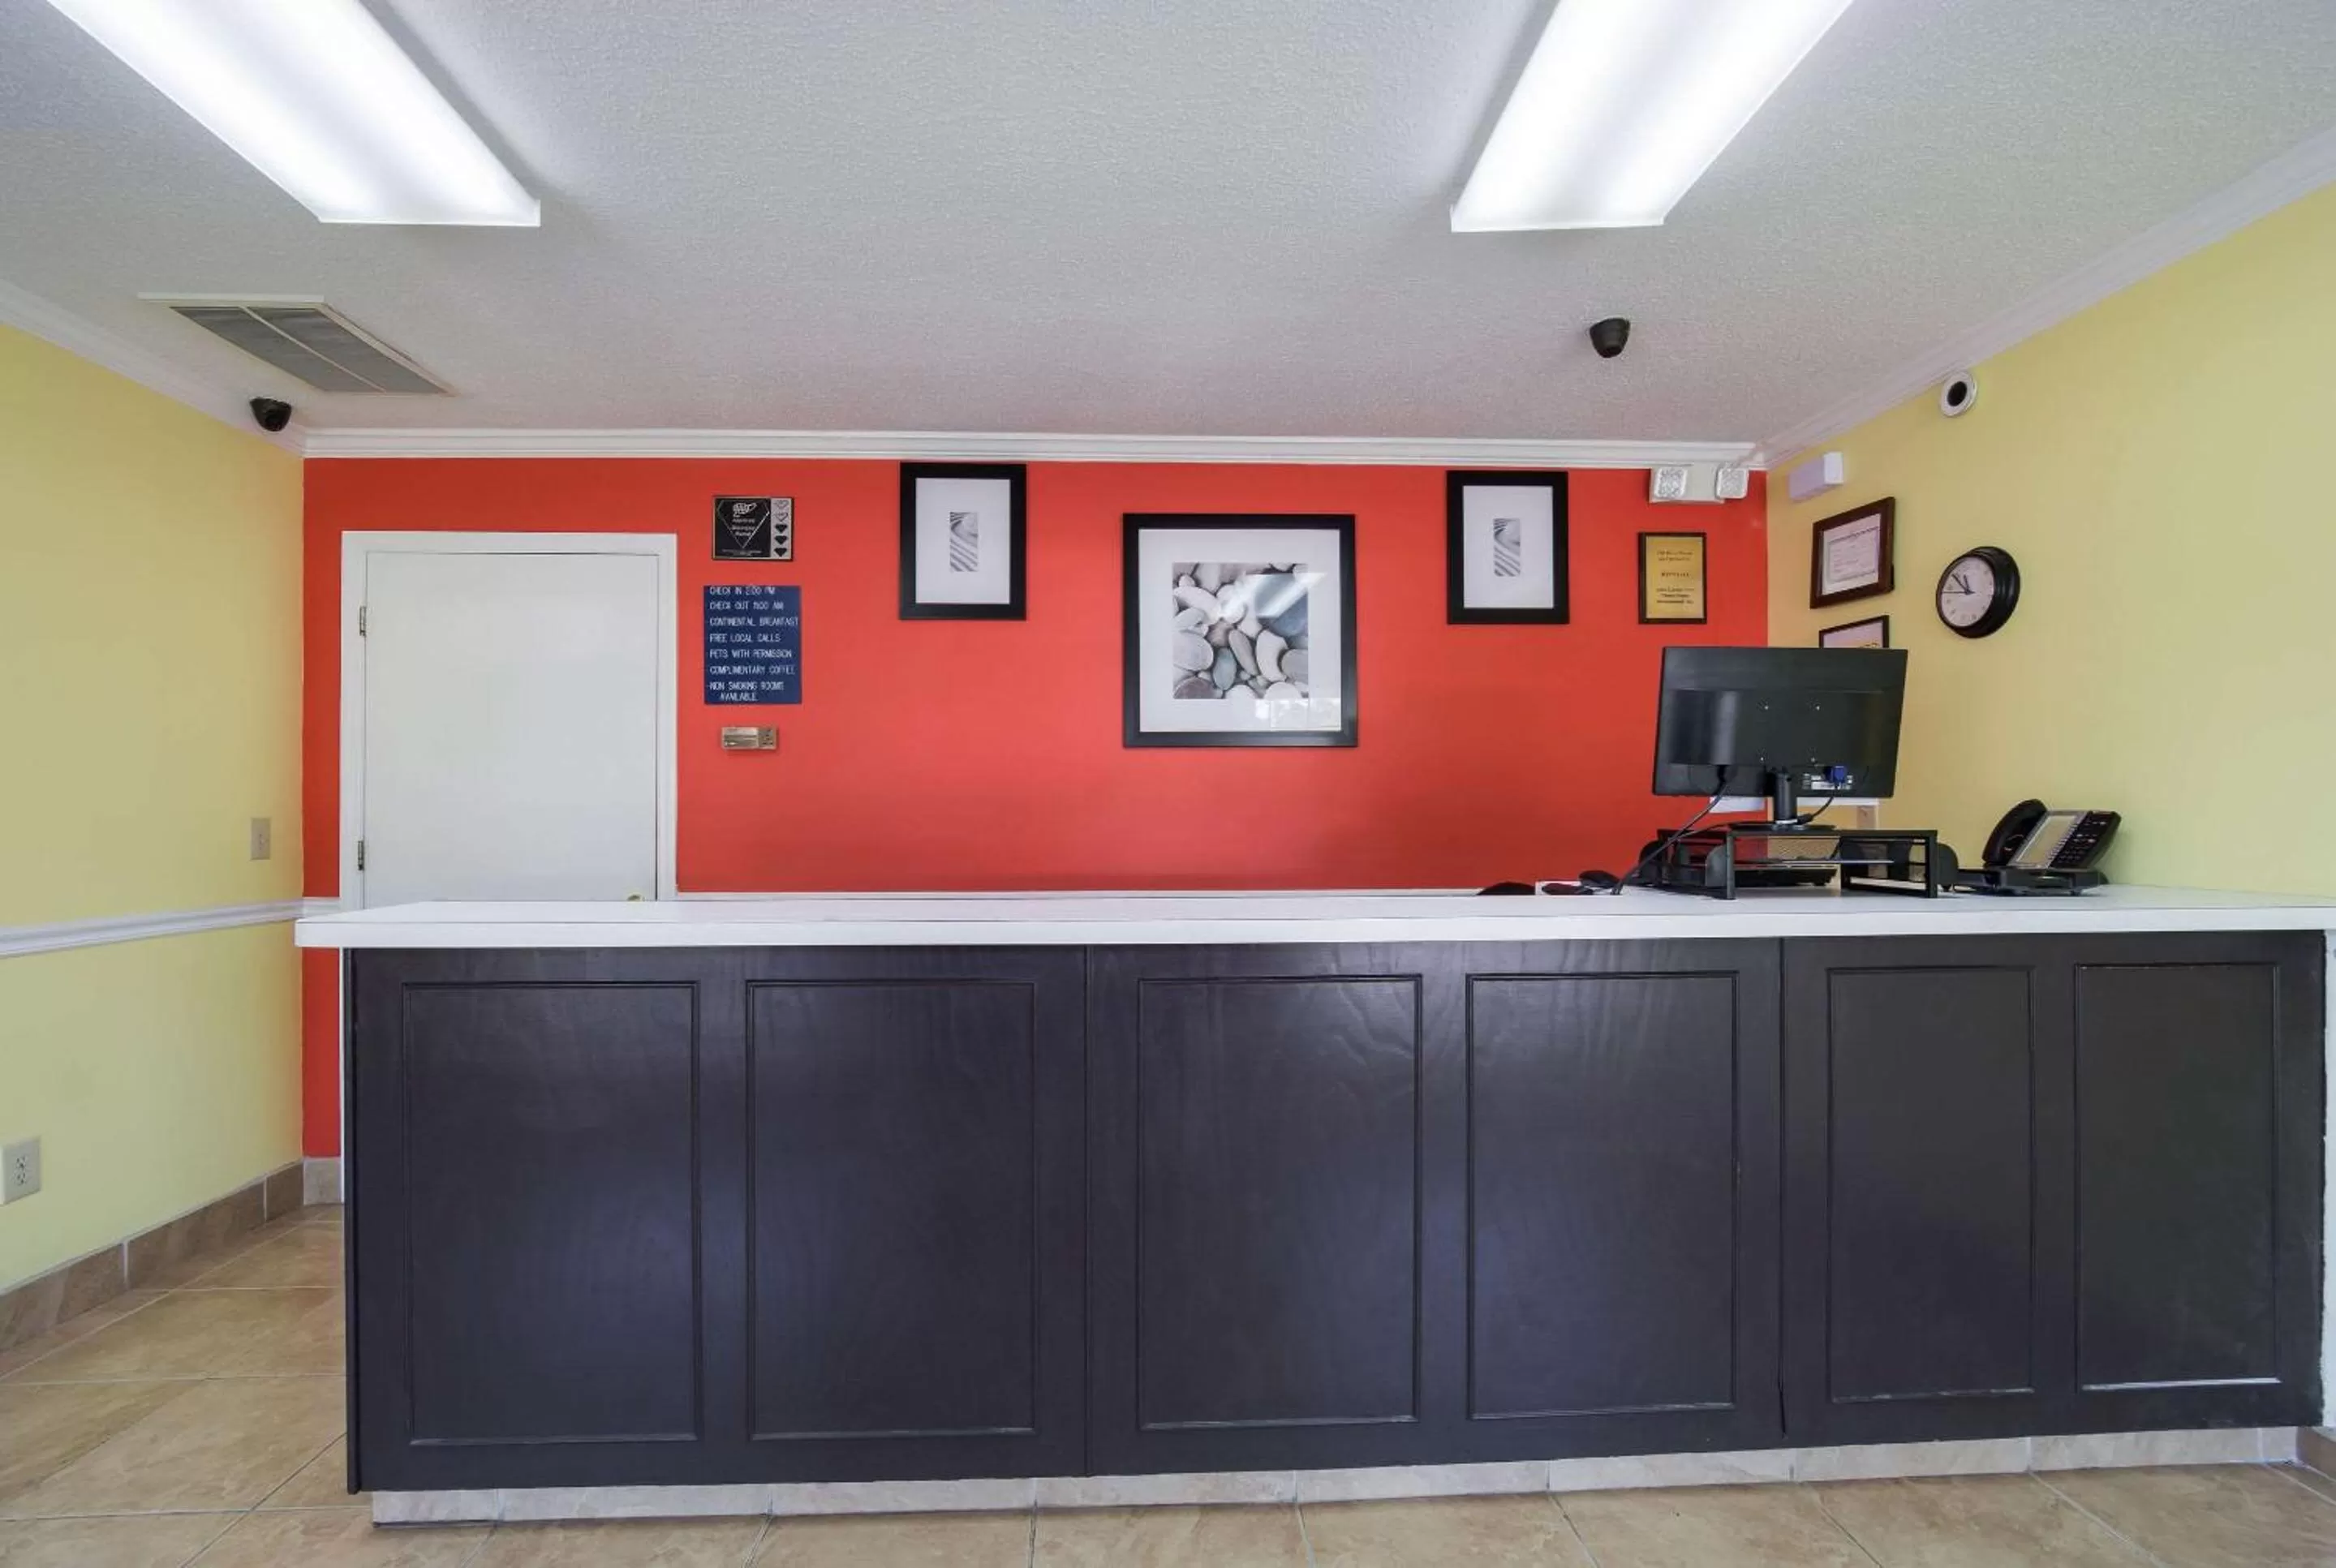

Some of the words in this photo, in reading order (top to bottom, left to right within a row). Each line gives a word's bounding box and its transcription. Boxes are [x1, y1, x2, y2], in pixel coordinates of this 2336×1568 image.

[709, 586, 731, 595] CHECK
[734, 586, 742, 595] IN
[709, 601, 731, 610] CHECK
[734, 601, 748, 610] OUT
[772, 601, 784, 610] AM
[709, 616, 756, 626] CONTINENTAL
[759, 616, 798, 626] BREAKFAST
[709, 633, 728, 642] FREE
[731, 633, 752, 642] LOCAL
[757, 633, 781, 642] CALLS
[709, 649, 728, 659] PETS
[732, 649, 750, 659] WITH
[753, 649, 792, 659] PERMISSION
[768, 665, 795, 675] COFFEE
[709, 681, 725, 690] NON
[729, 681, 758, 690] SMOKING
[761, 681, 784, 690] ROOMS
[720, 692, 759, 702] AVAILABLE
